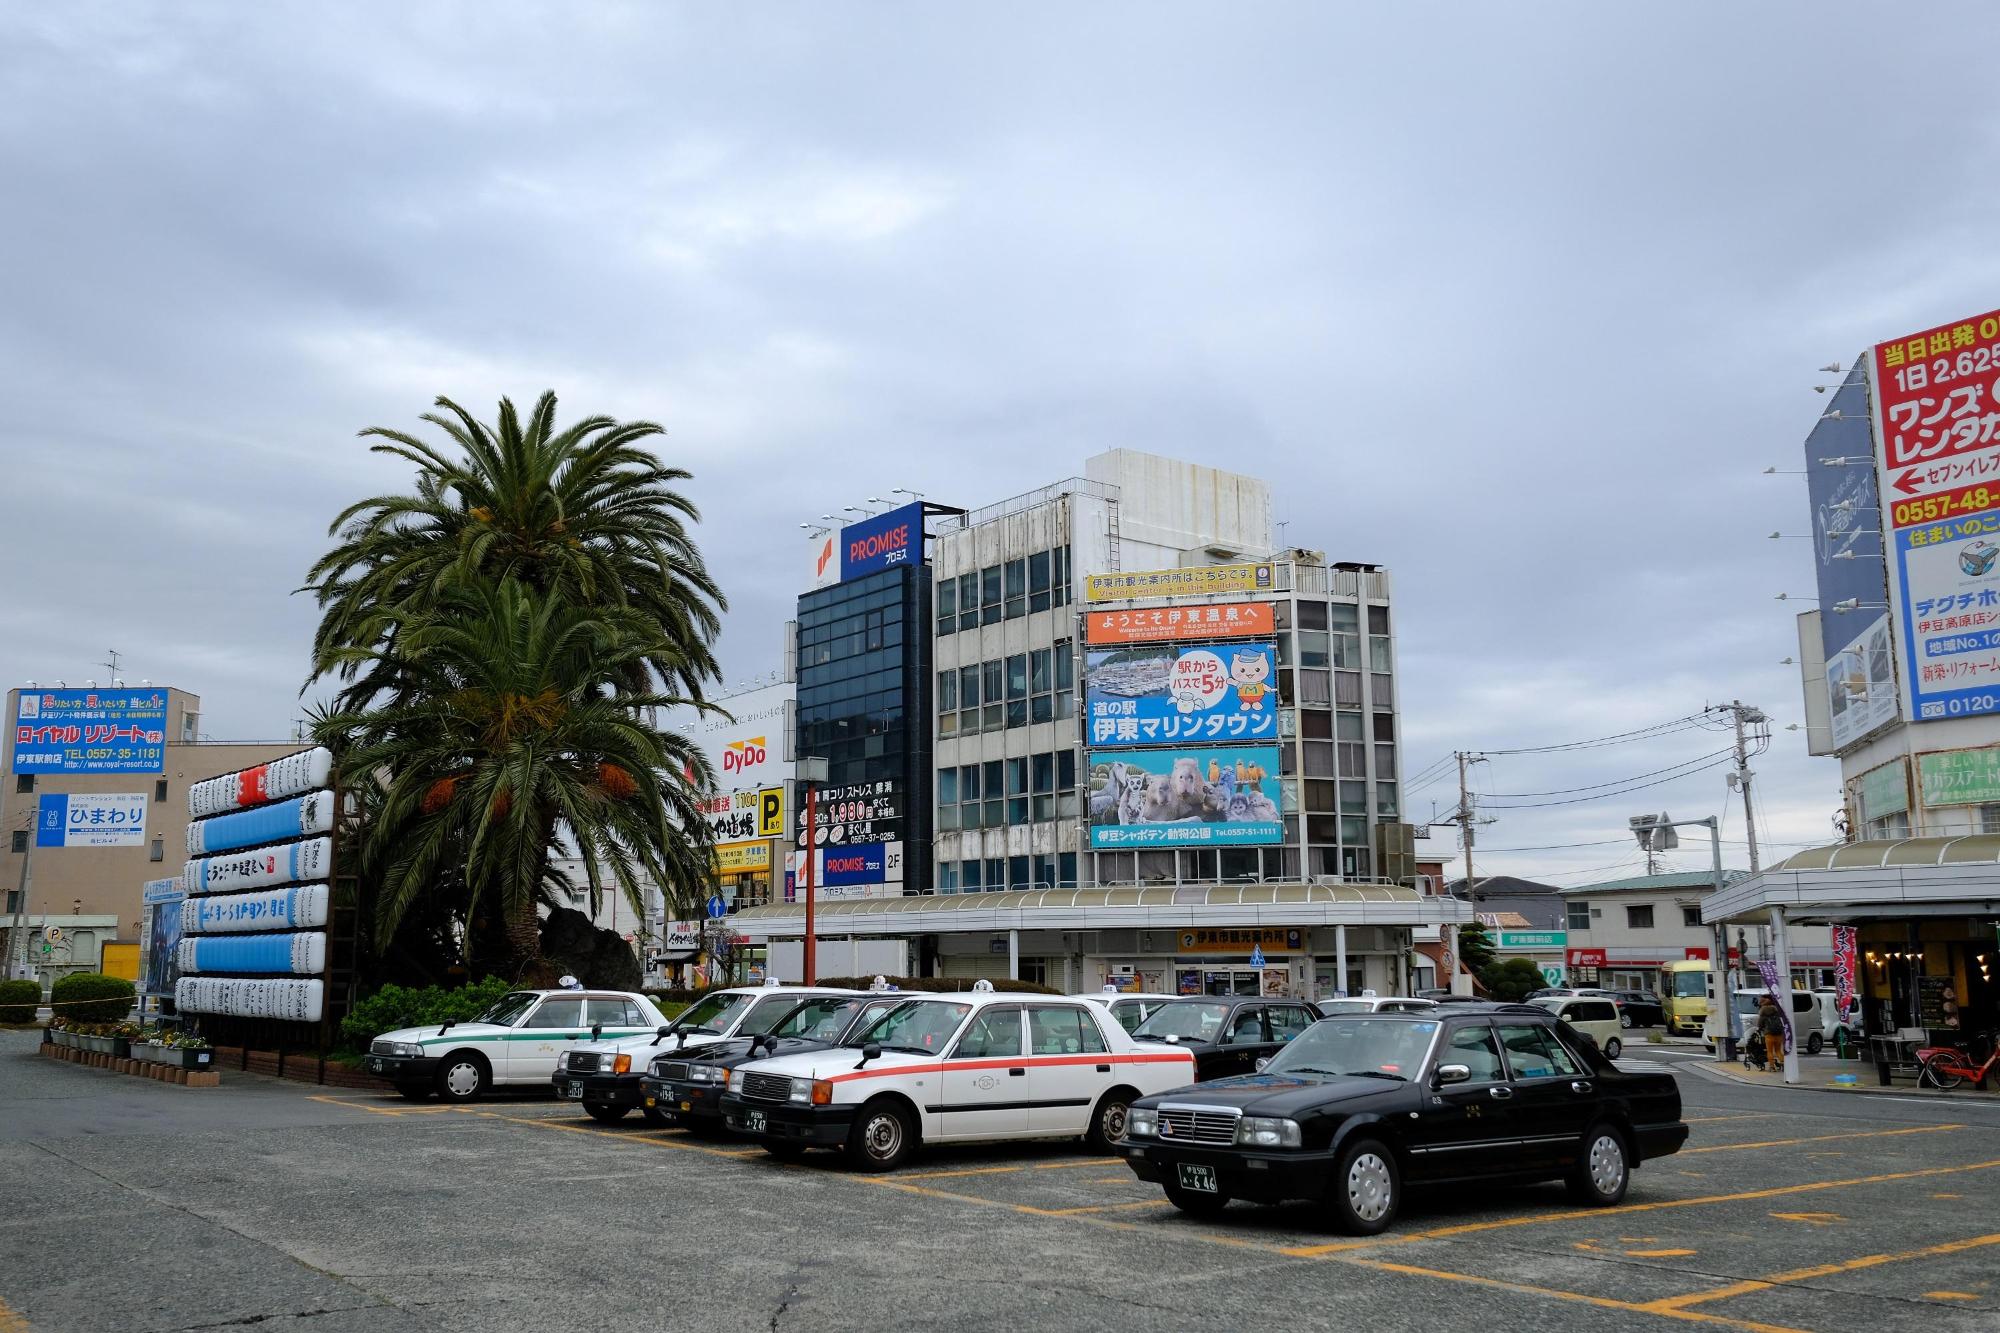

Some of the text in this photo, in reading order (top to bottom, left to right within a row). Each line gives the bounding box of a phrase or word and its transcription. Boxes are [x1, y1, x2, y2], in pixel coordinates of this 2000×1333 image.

[1885, 324, 1975, 368] 当日出発
[1895, 363, 1928, 392] 1日
[1889, 384, 1983, 431] ワンズ
[1909, 516, 2000, 547] 住まいのこ
[851, 524, 908, 563] PROMISE
[885, 548, 908, 565] プロミス
[1915, 589, 2000, 618] デグチホ
[1102, 607, 1258, 628] ようこそ伊東温泉へ
[1918, 611, 2000, 633] 伊豆高原店シ
[1178, 660, 1218, 674] 駅から
[1173, 674, 1226, 695] バスで5分
[1093, 700, 1137, 716] 道の駅
[1093, 713, 1272, 742] 伊東マリンタウン
[16, 754, 62, 764] 伊東駅前店
[64, 748, 161, 759] TEL 0557-35-1181
[723, 746, 766, 774] DyDo
[846, 783, 873, 798] ストレス
[872, 797, 889, 808] 安くて
[70, 808, 142, 824] ひまわり
[763, 794, 780, 830] P
[1098, 827, 1211, 842] 伊豆シャボテン動物公園
[827, 857, 865, 873] PROMISE
[865, 861, 881, 870] プロミス
[887, 853, 900, 869] 2F
[51, 928, 60, 940] P
[1197, 929, 1285, 944] 伊東市観光案内所
